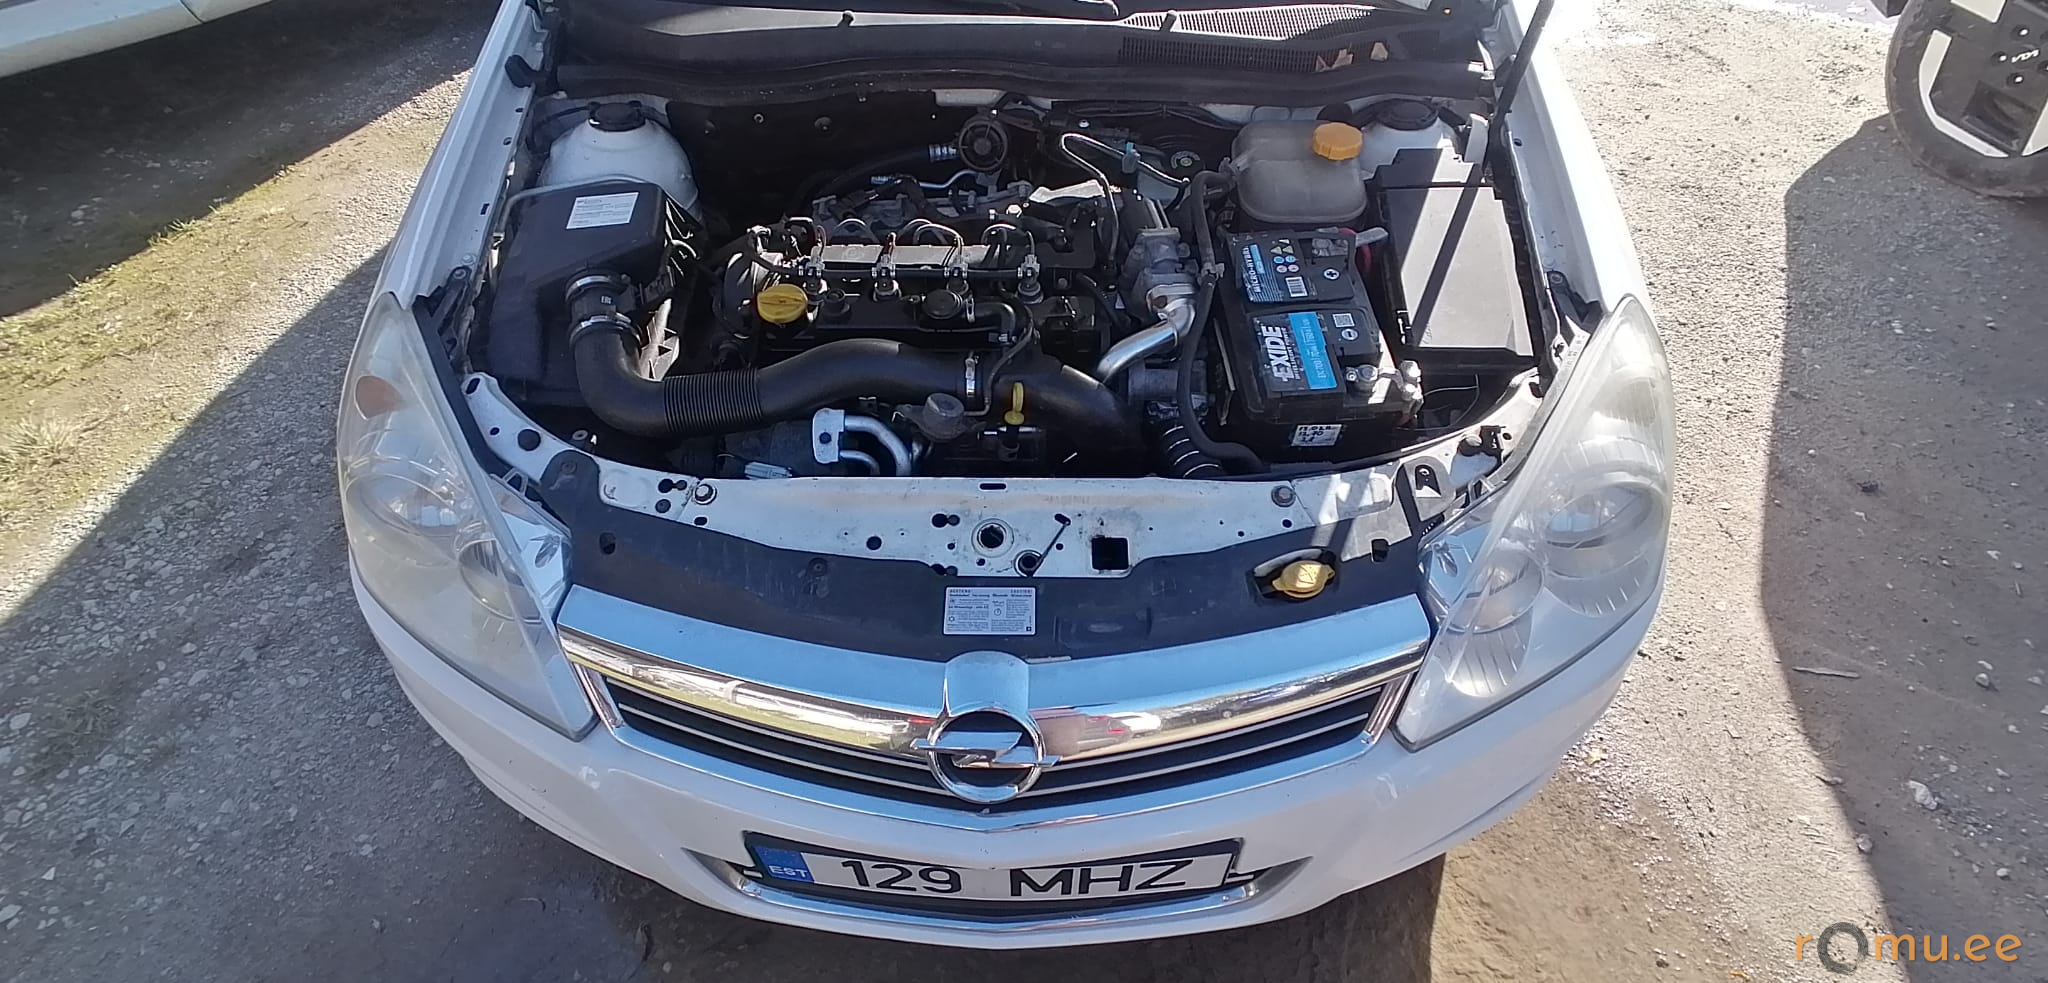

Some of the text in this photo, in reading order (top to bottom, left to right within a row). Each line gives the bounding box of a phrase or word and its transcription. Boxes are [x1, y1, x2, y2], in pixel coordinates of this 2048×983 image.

[1261, 325, 1295, 382] EXIDE
[768, 865, 809, 879] EST
[841, 859, 1194, 897] 129 MHZ
